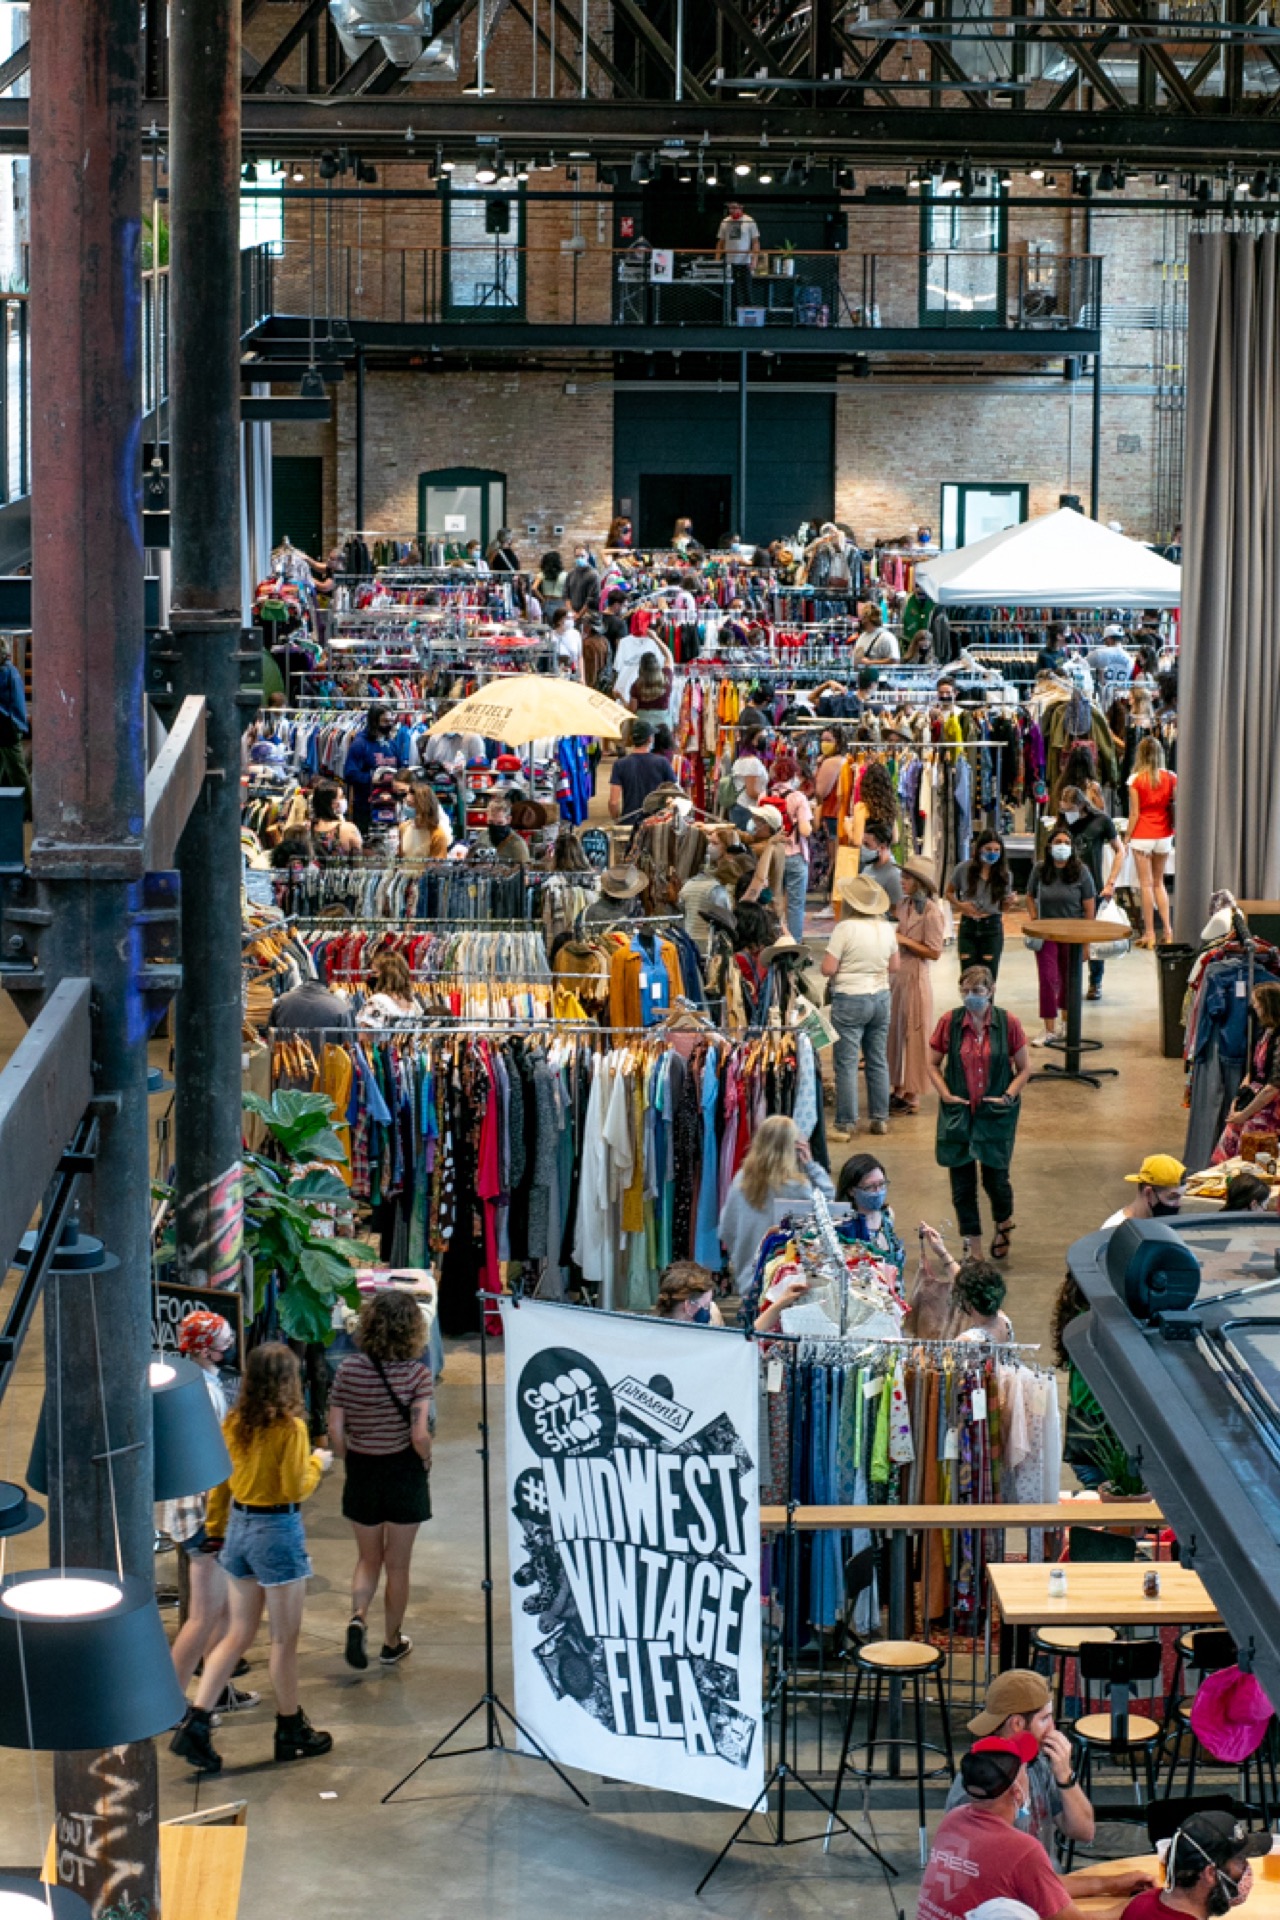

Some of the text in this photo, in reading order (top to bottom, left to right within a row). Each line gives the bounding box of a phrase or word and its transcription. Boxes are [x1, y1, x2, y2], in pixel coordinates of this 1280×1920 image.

[523, 1368, 592, 1410] GOOD
[534, 1386, 600, 1435] STYLE
[542, 1413, 602, 1453] SHOP
[556, 1538, 746, 1669] VINTAGE
[603, 1637, 717, 1757] FLEA
